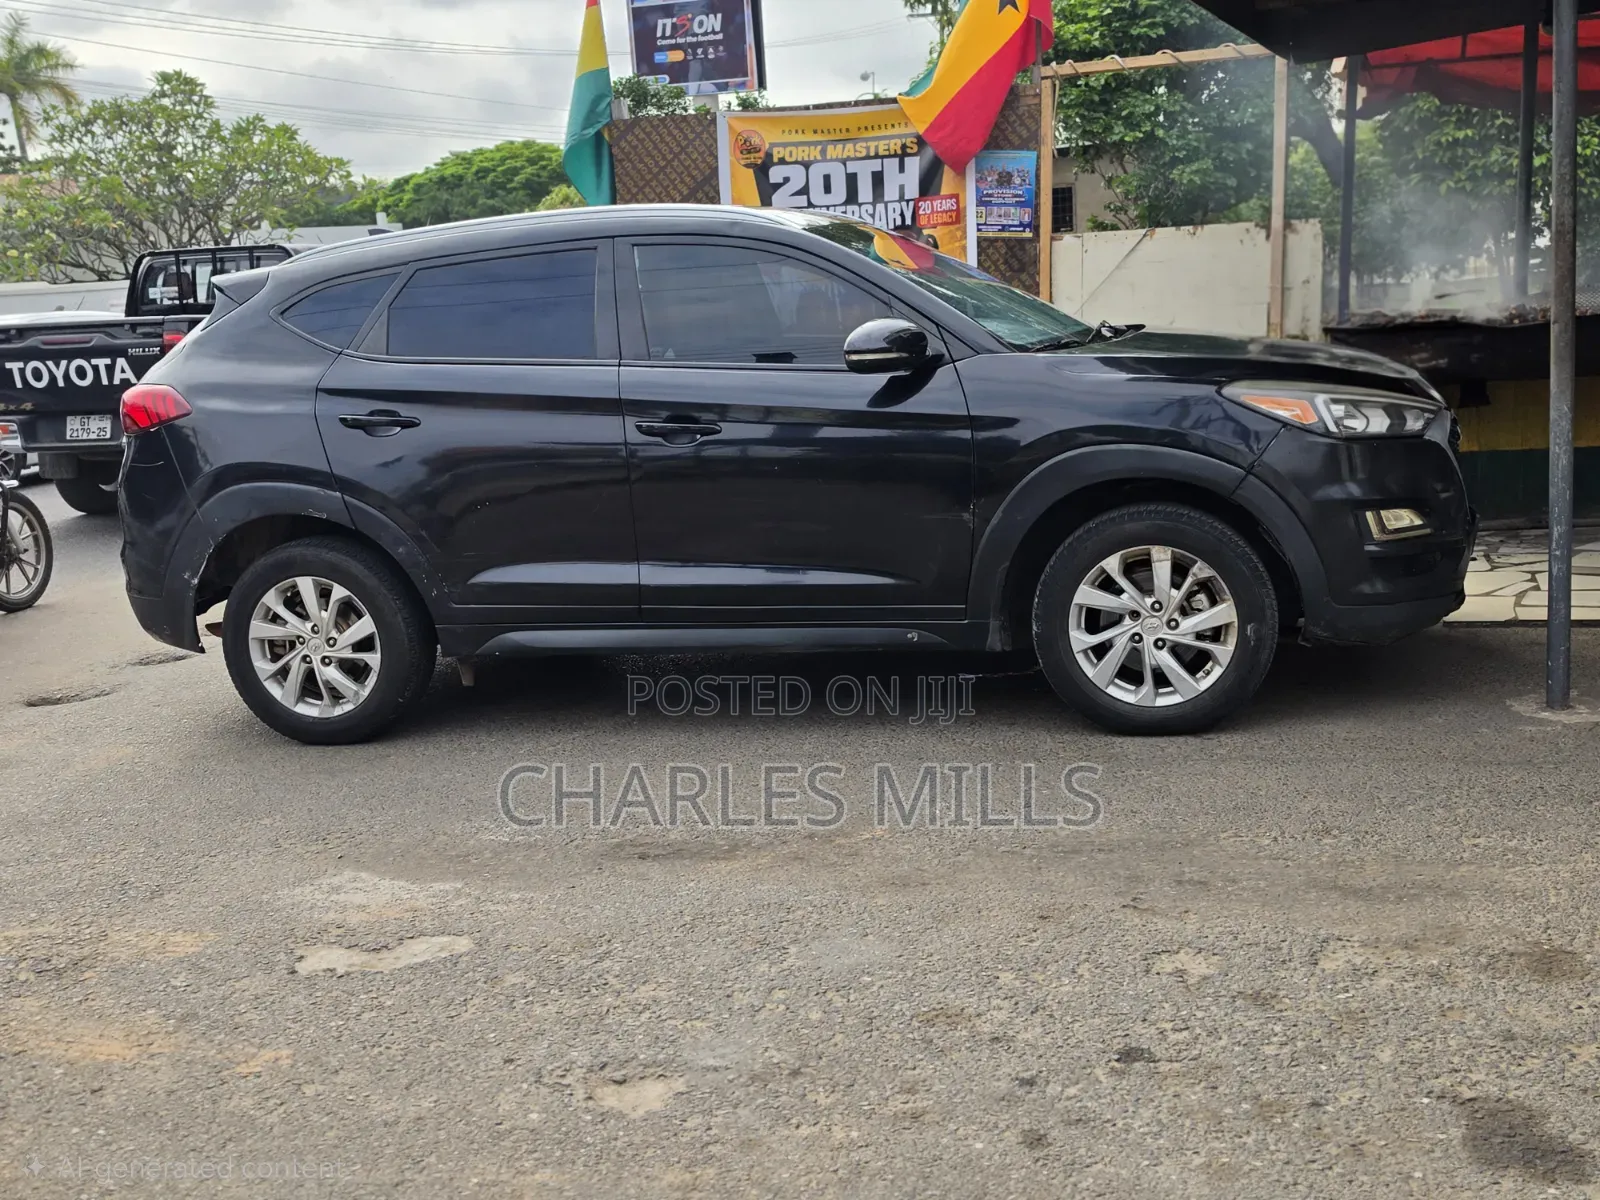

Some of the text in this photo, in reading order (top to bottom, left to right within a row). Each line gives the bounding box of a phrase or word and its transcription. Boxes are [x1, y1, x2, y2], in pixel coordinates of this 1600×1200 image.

[693, 13, 722, 34] ON
[657, 38, 676, 46] Come
[686, 35, 698, 43] the
[698, 33, 723, 42] football
[781, 121, 909, 136] PORK MASTER PRESENTS
[772, 137, 919, 163] PORK MASTER'S
[768, 156, 920, 208] 20TH
[919, 198, 957, 215] 20 YEARS
[920, 211, 957, 225] OF LEGACY
[128, 347, 161, 356] HILUX
[5, 357, 139, 389] TOYOTA
[80, 416, 91, 427] GT
[69, 427, 108, 438] 2179-25
